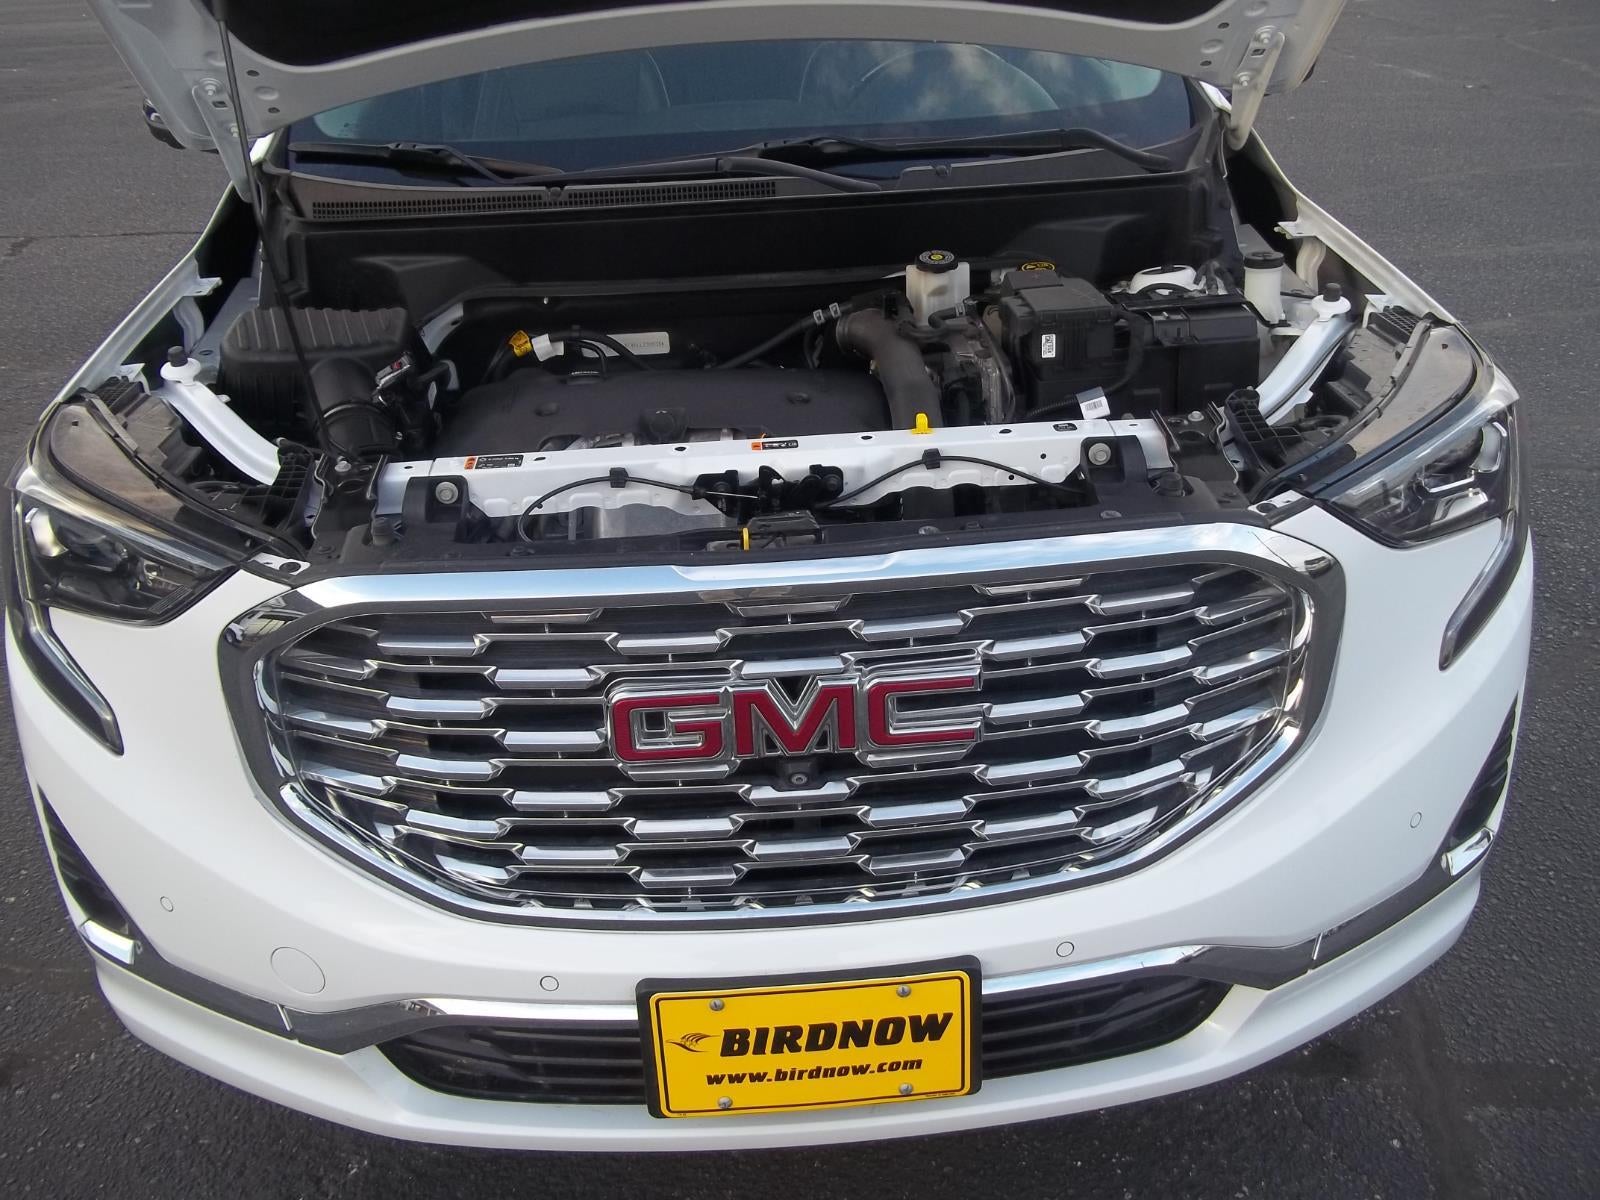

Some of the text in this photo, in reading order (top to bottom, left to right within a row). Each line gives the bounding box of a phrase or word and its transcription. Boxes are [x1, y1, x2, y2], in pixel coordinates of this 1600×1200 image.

[609, 670, 980, 764] GMC
[719, 1012, 953, 1057] BIRDNOW
[706, 1058, 922, 1085] www.birdnow.com
